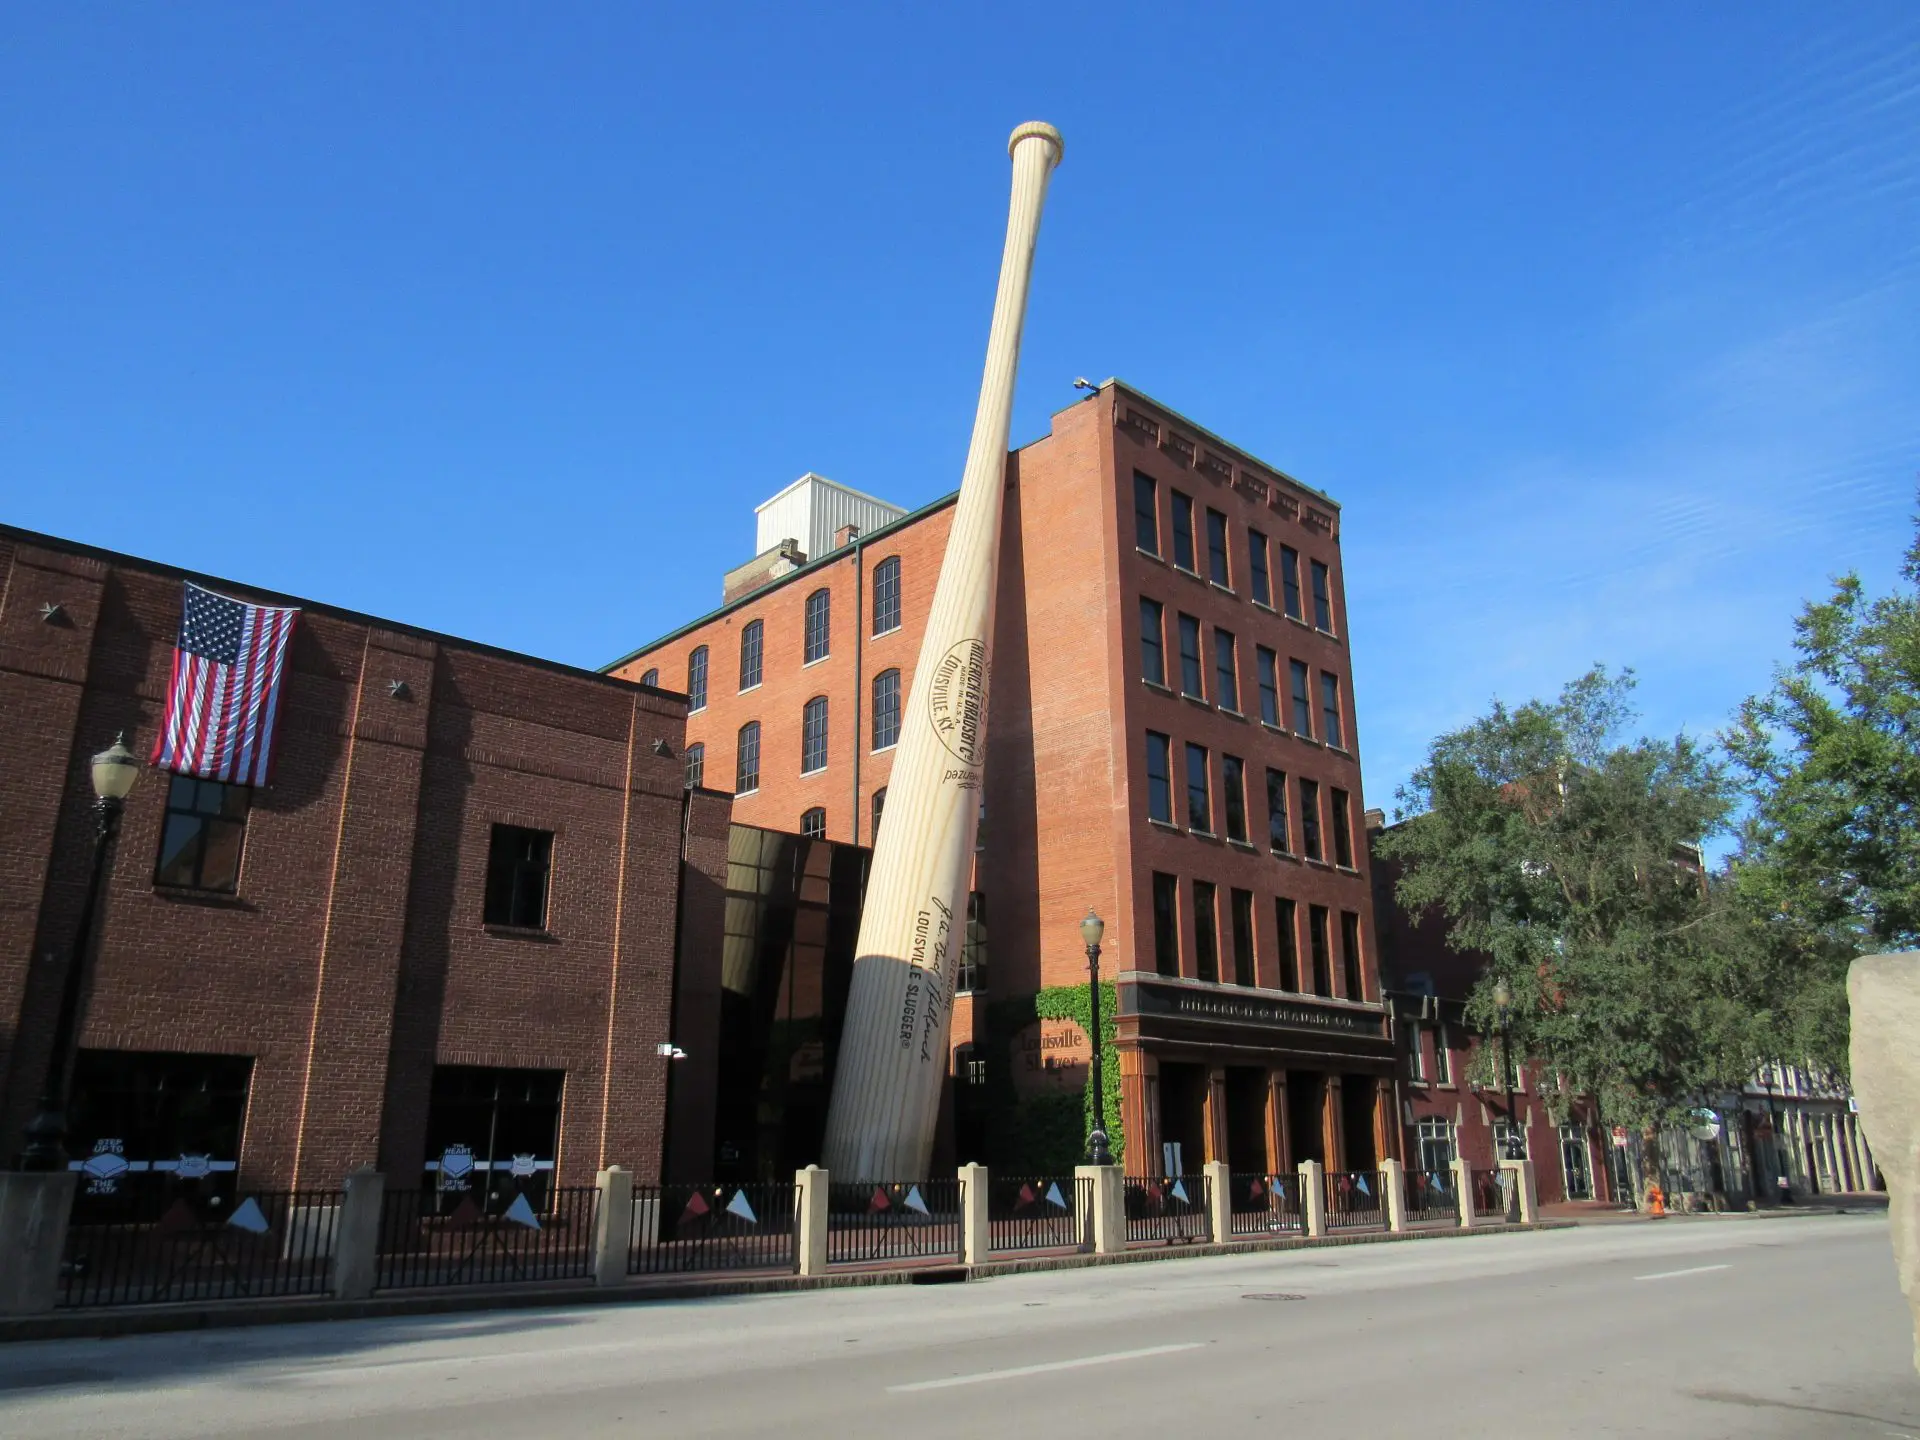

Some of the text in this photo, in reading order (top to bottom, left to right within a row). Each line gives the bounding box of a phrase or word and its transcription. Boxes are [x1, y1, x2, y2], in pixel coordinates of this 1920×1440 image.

[967, 642, 984, 689] HILLERICH
[959, 690, 964, 698] IN
[966, 691, 978, 701] &
[961, 699, 979, 748] BRADSBY
[909, 911, 930, 981] LOUISVILLE
[1022, 1028, 1082, 1050] Louisville
